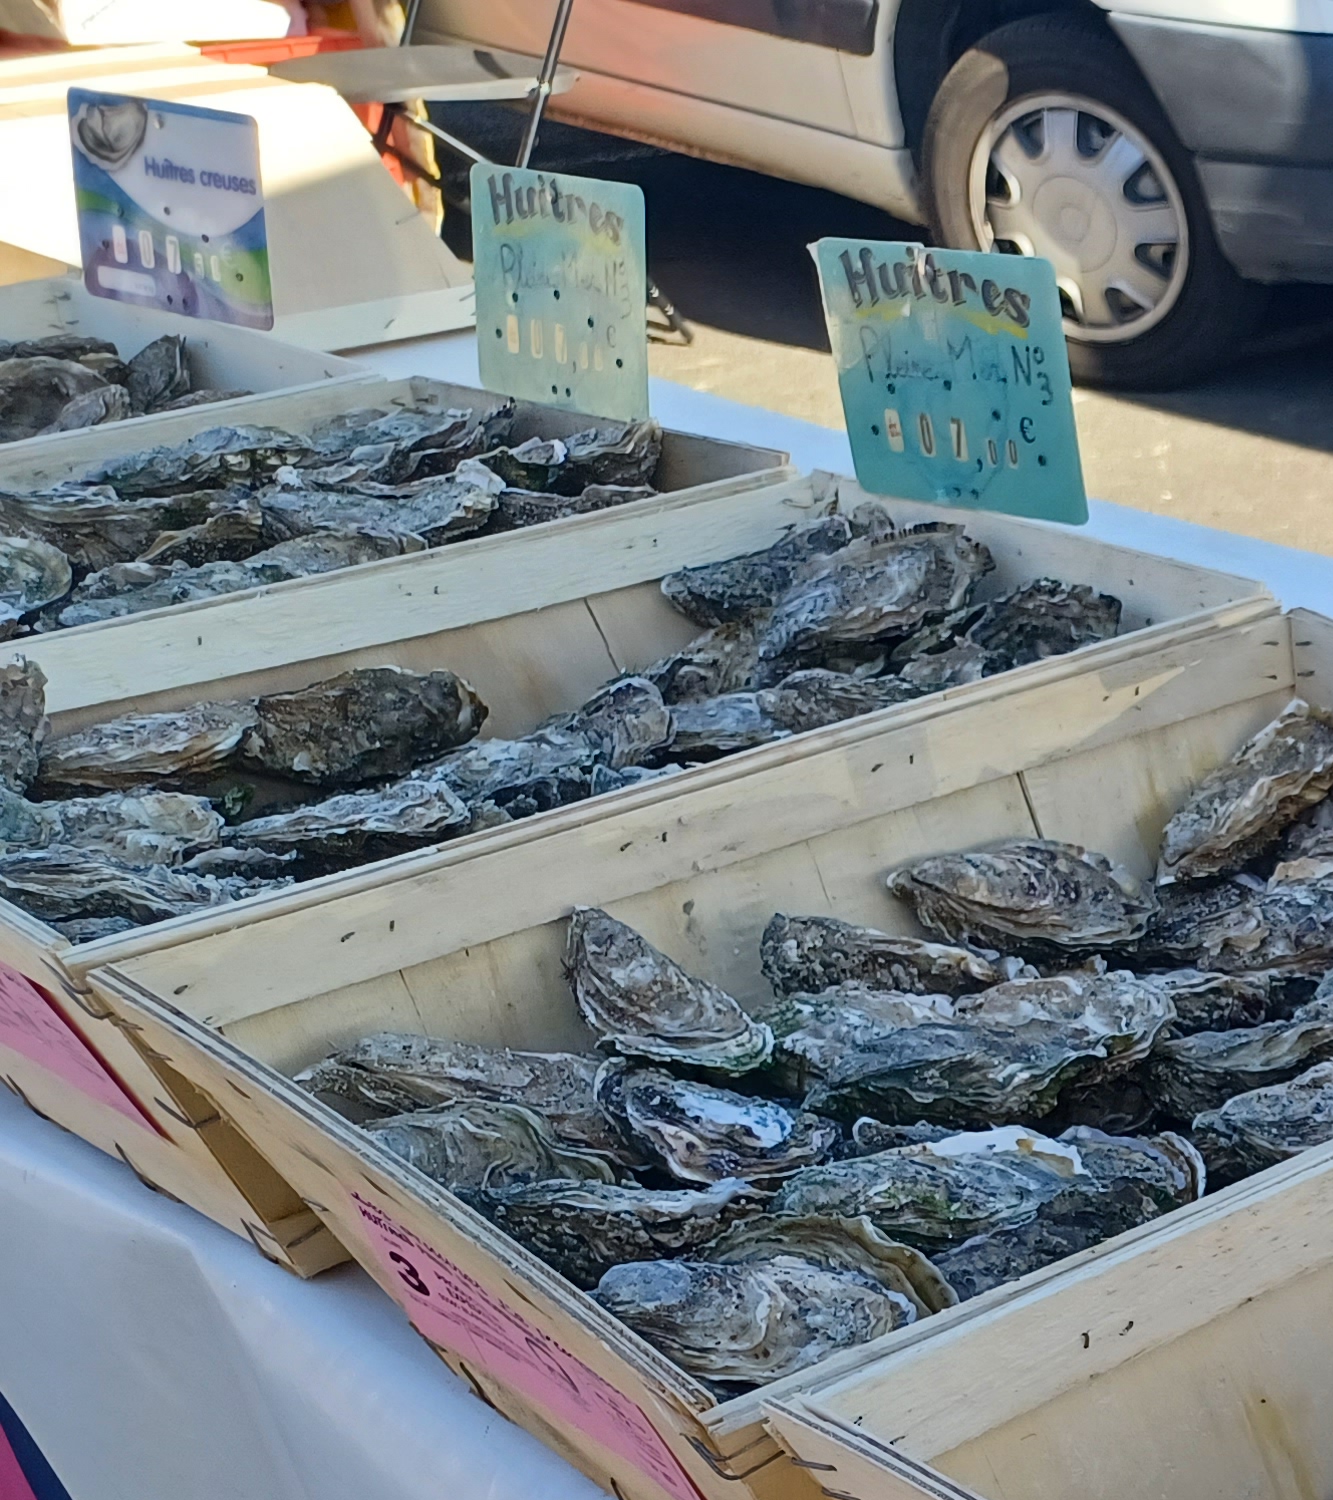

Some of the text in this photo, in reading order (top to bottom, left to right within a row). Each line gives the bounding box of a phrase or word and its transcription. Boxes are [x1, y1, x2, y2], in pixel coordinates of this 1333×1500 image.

[144, 155, 257, 196] Huîtres creuses
[487, 172, 625, 246] Huitres
[839, 246, 1032, 328] Huitres
[388, 1250, 431, 1297] 3
